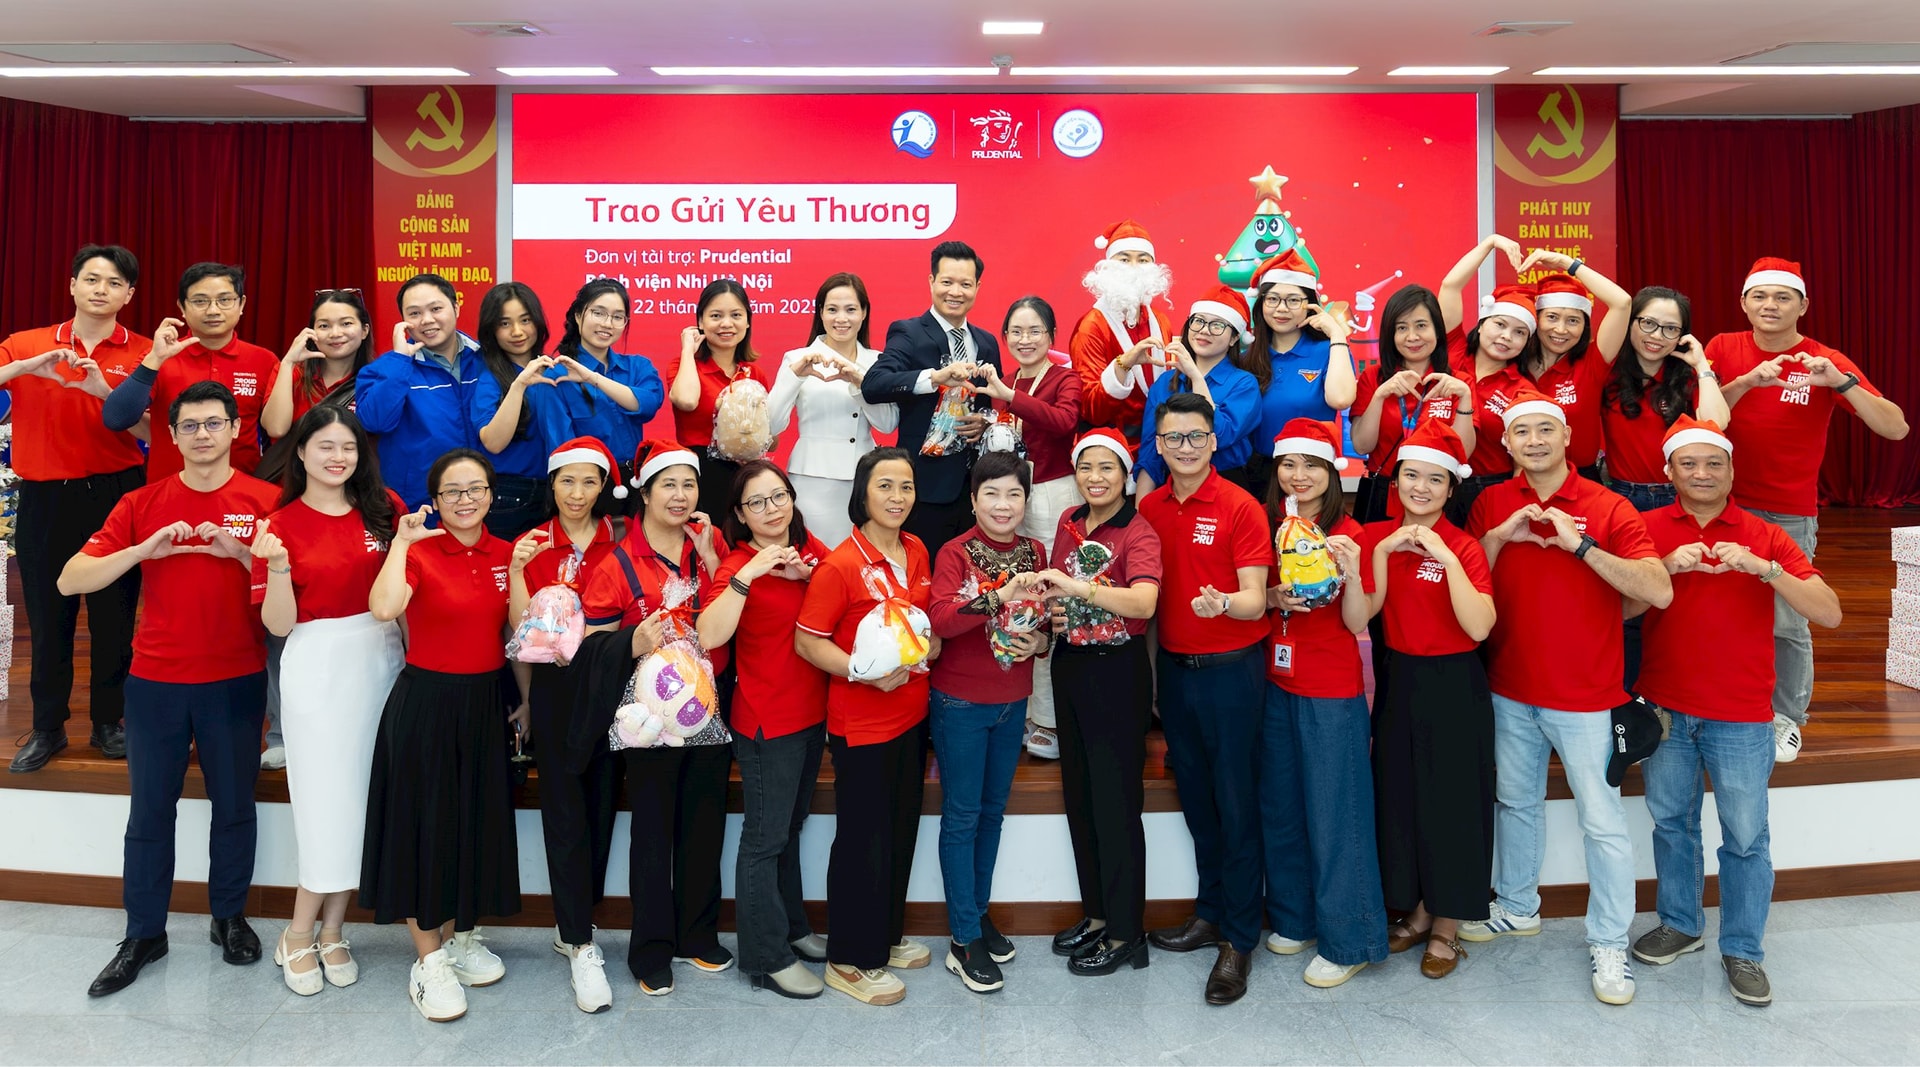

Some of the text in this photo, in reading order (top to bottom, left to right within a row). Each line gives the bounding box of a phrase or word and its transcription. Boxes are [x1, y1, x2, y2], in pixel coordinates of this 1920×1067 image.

[972, 150, 1023, 159] PRUDENTIAL
[416, 189, 454, 209] ĐẢNG
[1519, 199, 1591, 216] PHÁT HUY
[585, 196, 930, 230] Trao Gửi Yêu Thương
[400, 213, 470, 236] CỘNG SẢN
[1518, 220, 1593, 240] BẢN LĨNH,
[398, 239, 427, 260] VIỆT
[430, 242, 462, 258] NAM
[585, 248, 792, 266] Đơn vị tài trợ: Prudential
[462, 267, 494, 285] ĐẠO,
[585, 273, 630, 289] Bh
[634, 273, 671, 291] viện
[676, 273, 708, 289] Nhi
[742, 273, 773, 291] Nội
[633, 299, 655, 314] 22
[659, 299, 697, 314] thán
[750, 299, 775, 314] ăm
[232, 386, 256, 396] PRU
[1428, 409, 1452, 419] PRU
[223, 514, 255, 522] PROUD
[1192, 533, 1215, 546] PRU
[1416, 569, 1443, 583] PRU
